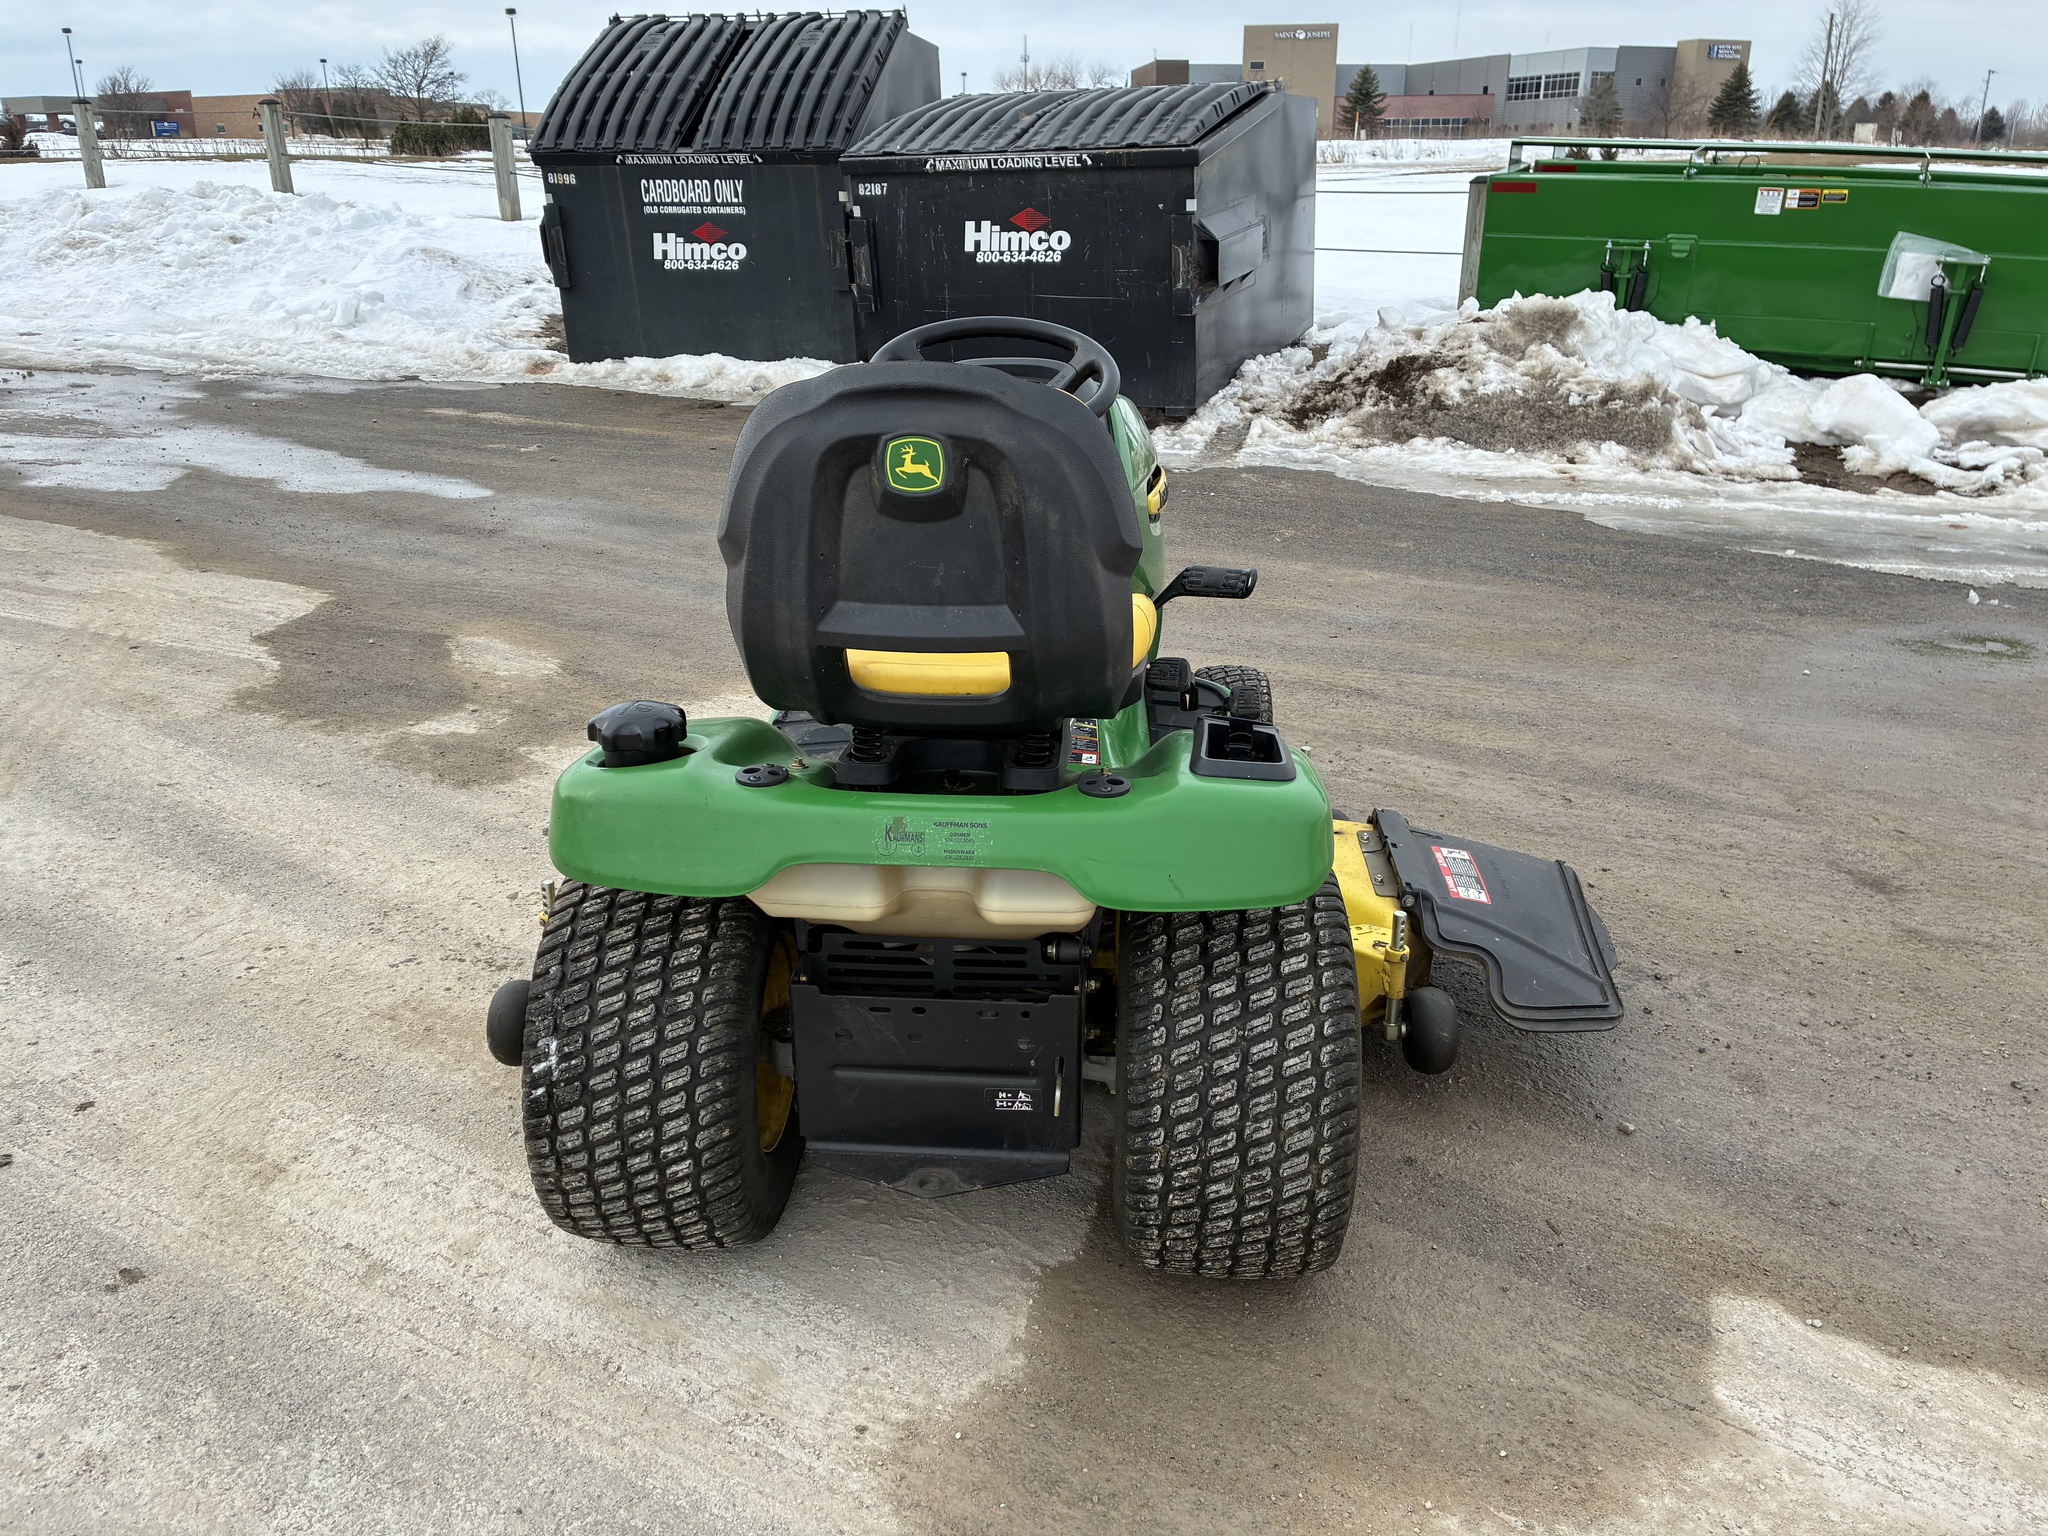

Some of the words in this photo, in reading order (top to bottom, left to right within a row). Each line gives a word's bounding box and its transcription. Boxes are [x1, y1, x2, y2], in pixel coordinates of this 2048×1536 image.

[1274, 31, 1295, 39] SAINT
[625, 155, 672, 165] MAXIMUM
[674, 155, 719, 164] LOADING
[721, 154, 754, 164] LEVEL
[991, 157, 1042, 170] LOADING
[1045, 156, 1081, 168] LEVEL
[548, 172, 576, 185] 81996
[641, 179, 711, 203] CARDBOARD
[714, 179, 743, 203] ONLY
[858, 183, 888, 196] 82187
[643, 206, 659, 215] (OLD
[660, 206, 701, 214] CORRUGATED
[703, 206, 746, 215] CONTAINERS)
[964, 220, 1072, 252] Himco
[653, 232, 747, 260] Himco
[976, 251, 1062, 263] 800-634-4626
[664, 260, 739, 270] 800-634-4626
